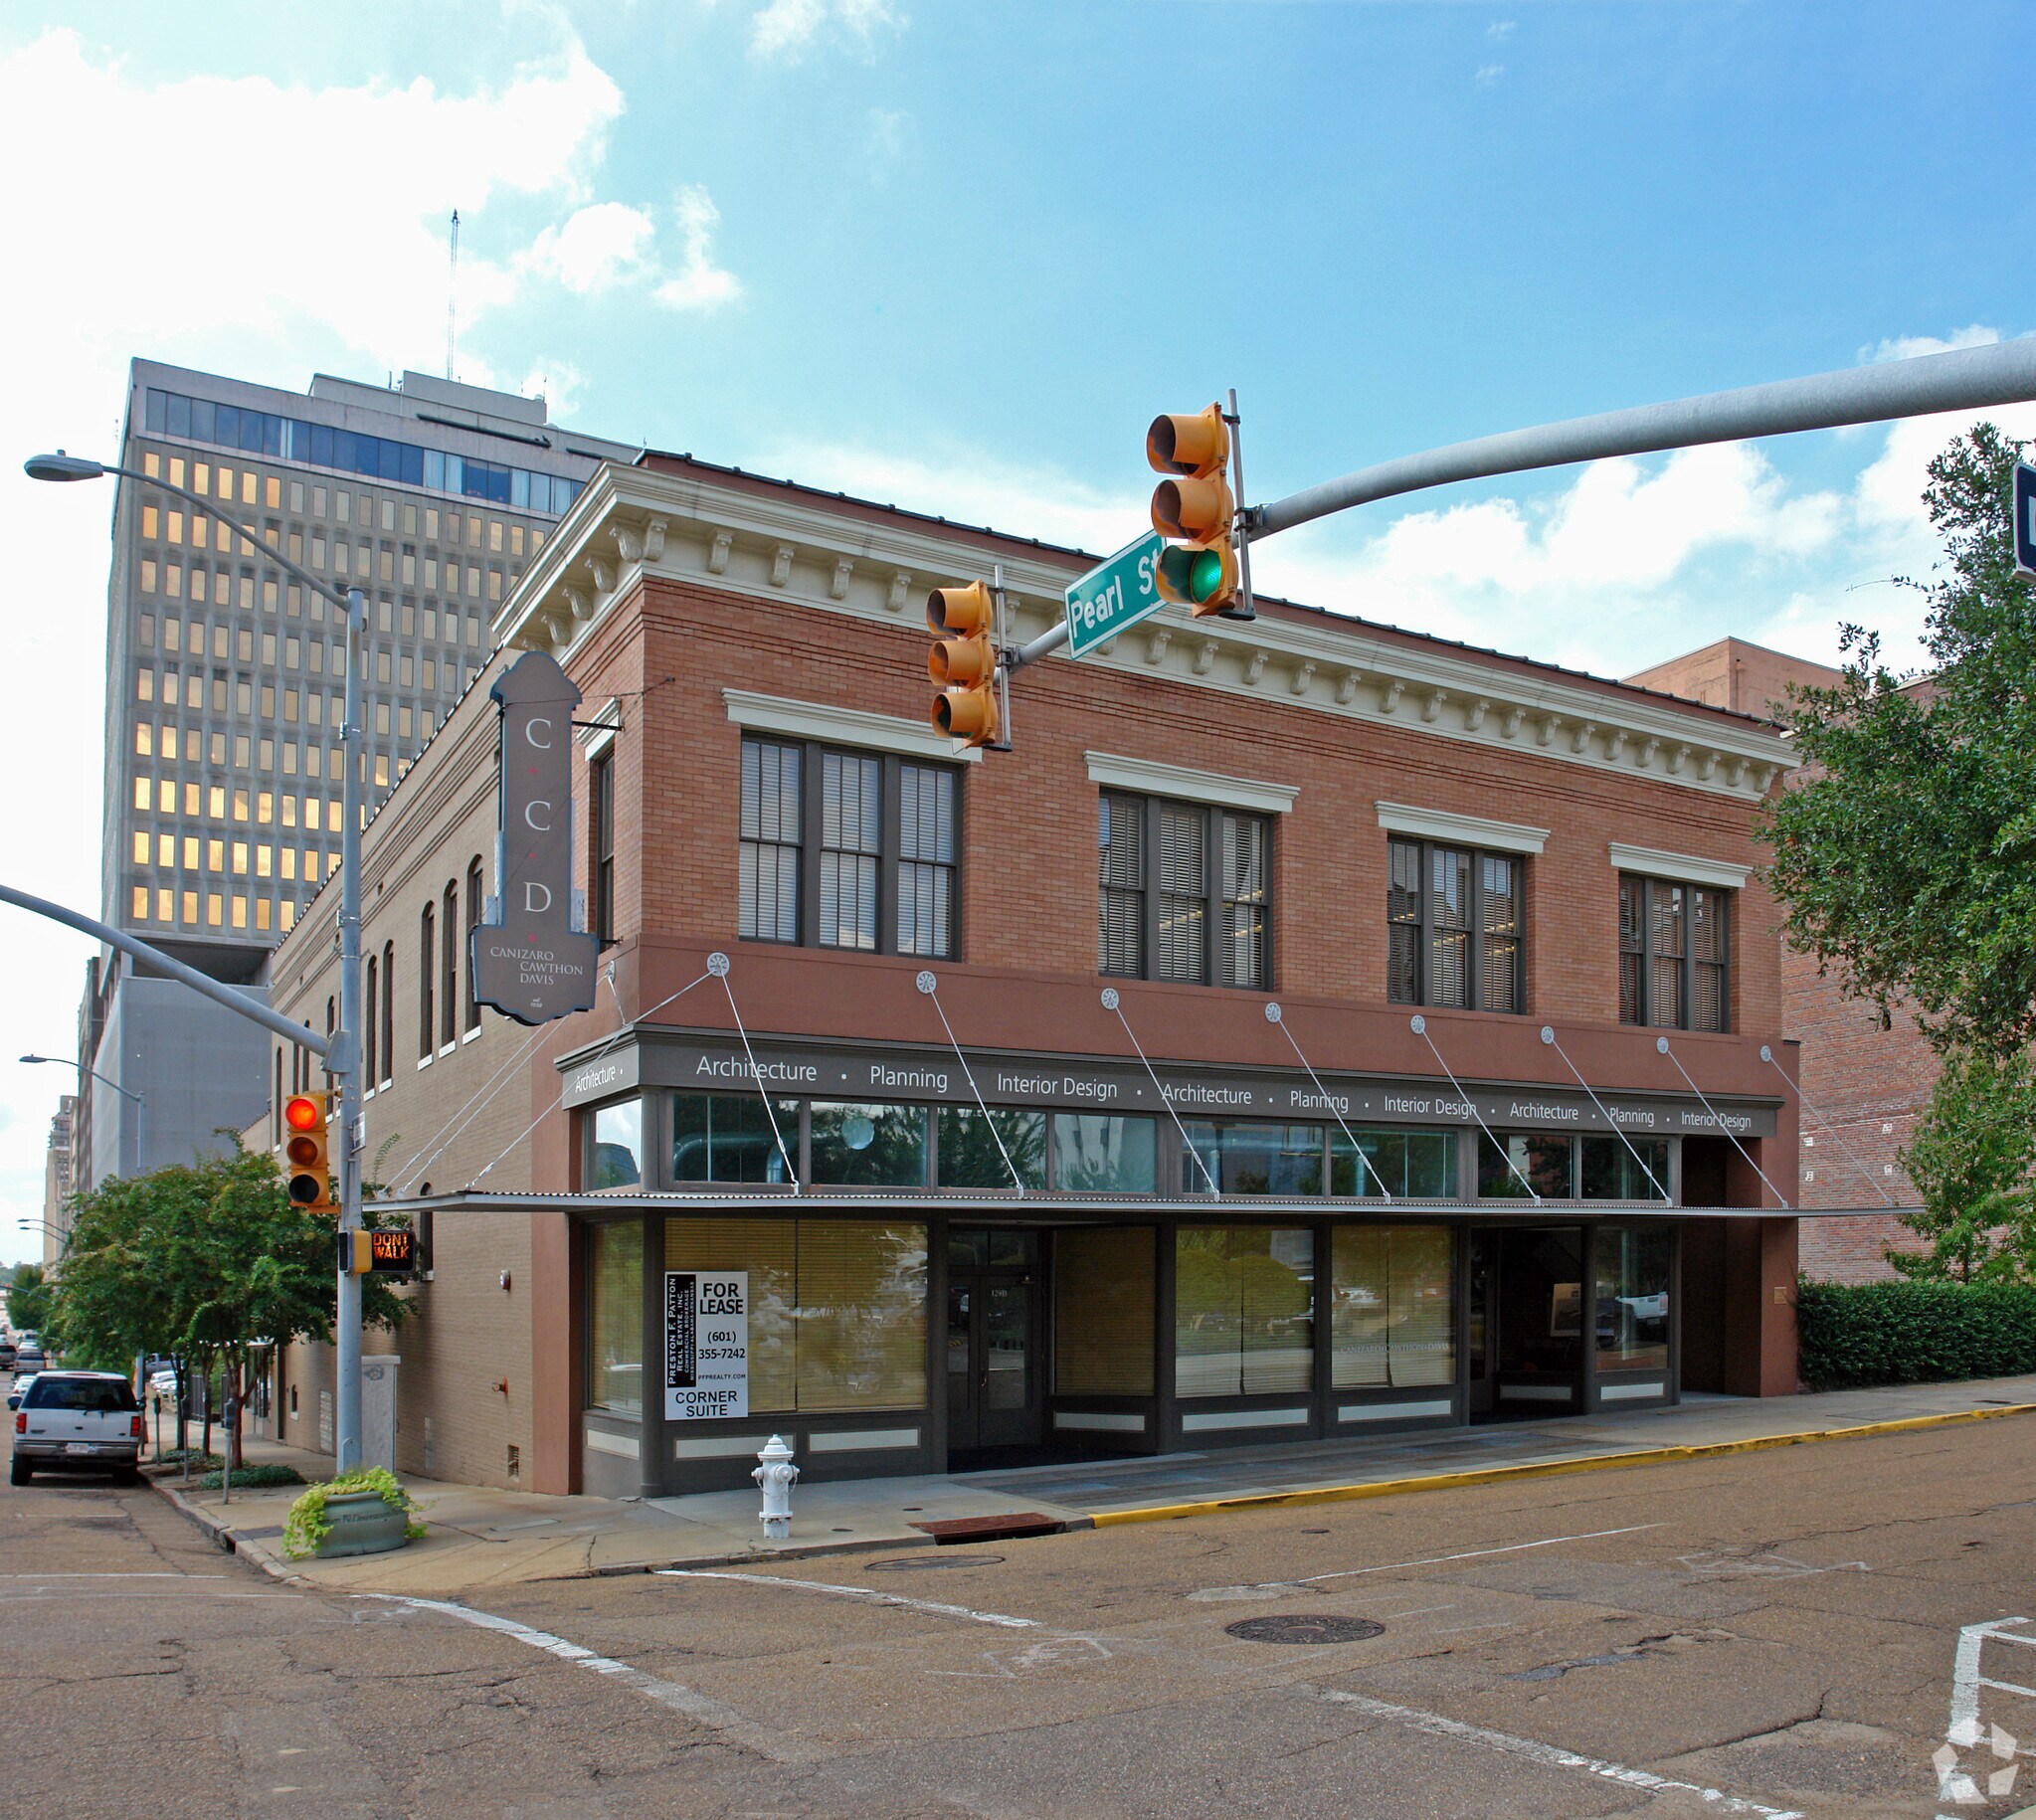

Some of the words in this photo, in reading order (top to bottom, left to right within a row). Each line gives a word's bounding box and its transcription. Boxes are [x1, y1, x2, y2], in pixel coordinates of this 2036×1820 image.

[1070, 575, 1124, 638] Pearl
[525, 718, 551, 749] C
[524, 801, 551, 831] C
[524, 882, 552, 913] D
[490, 946, 554, 962] CANIZARO
[520, 961, 584, 976] CAWTHON
[520, 973, 554, 985] DAVIS
[575, 1065, 616, 1093] Architecture
[696, 1055, 817, 1081] Architecture
[870, 1065, 948, 1093] Planning
[998, 1073, 1057, 1094] Interior
[1063, 1077, 1117, 1101] Design
[1162, 1083, 1252, 1105] Architecture
[1290, 1090, 1349, 1113] Planning
[1385, 1096, 1430, 1113] Interior
[1435, 1098, 1477, 1120] Design
[1510, 1102, 1578, 1120] Architecture
[1609, 1107, 1655, 1127] Planning
[1681, 1111, 1717, 1127] Interior
[1719, 1113, 1752, 1132] Design
[373, 1233, 409, 1246] DONT
[373, 1245, 409, 1259] WALK
[703, 1283, 739, 1298] FOR
[700, 1299, 743, 1314] LEASE
[668, 1322, 676, 1331] F.
[708, 1331, 736, 1344] (601)
[699, 1349, 745, 1359] 355-7242
[676, 1390, 738, 1404] CORNER
[686, 1404, 728, 1416] SUITE
